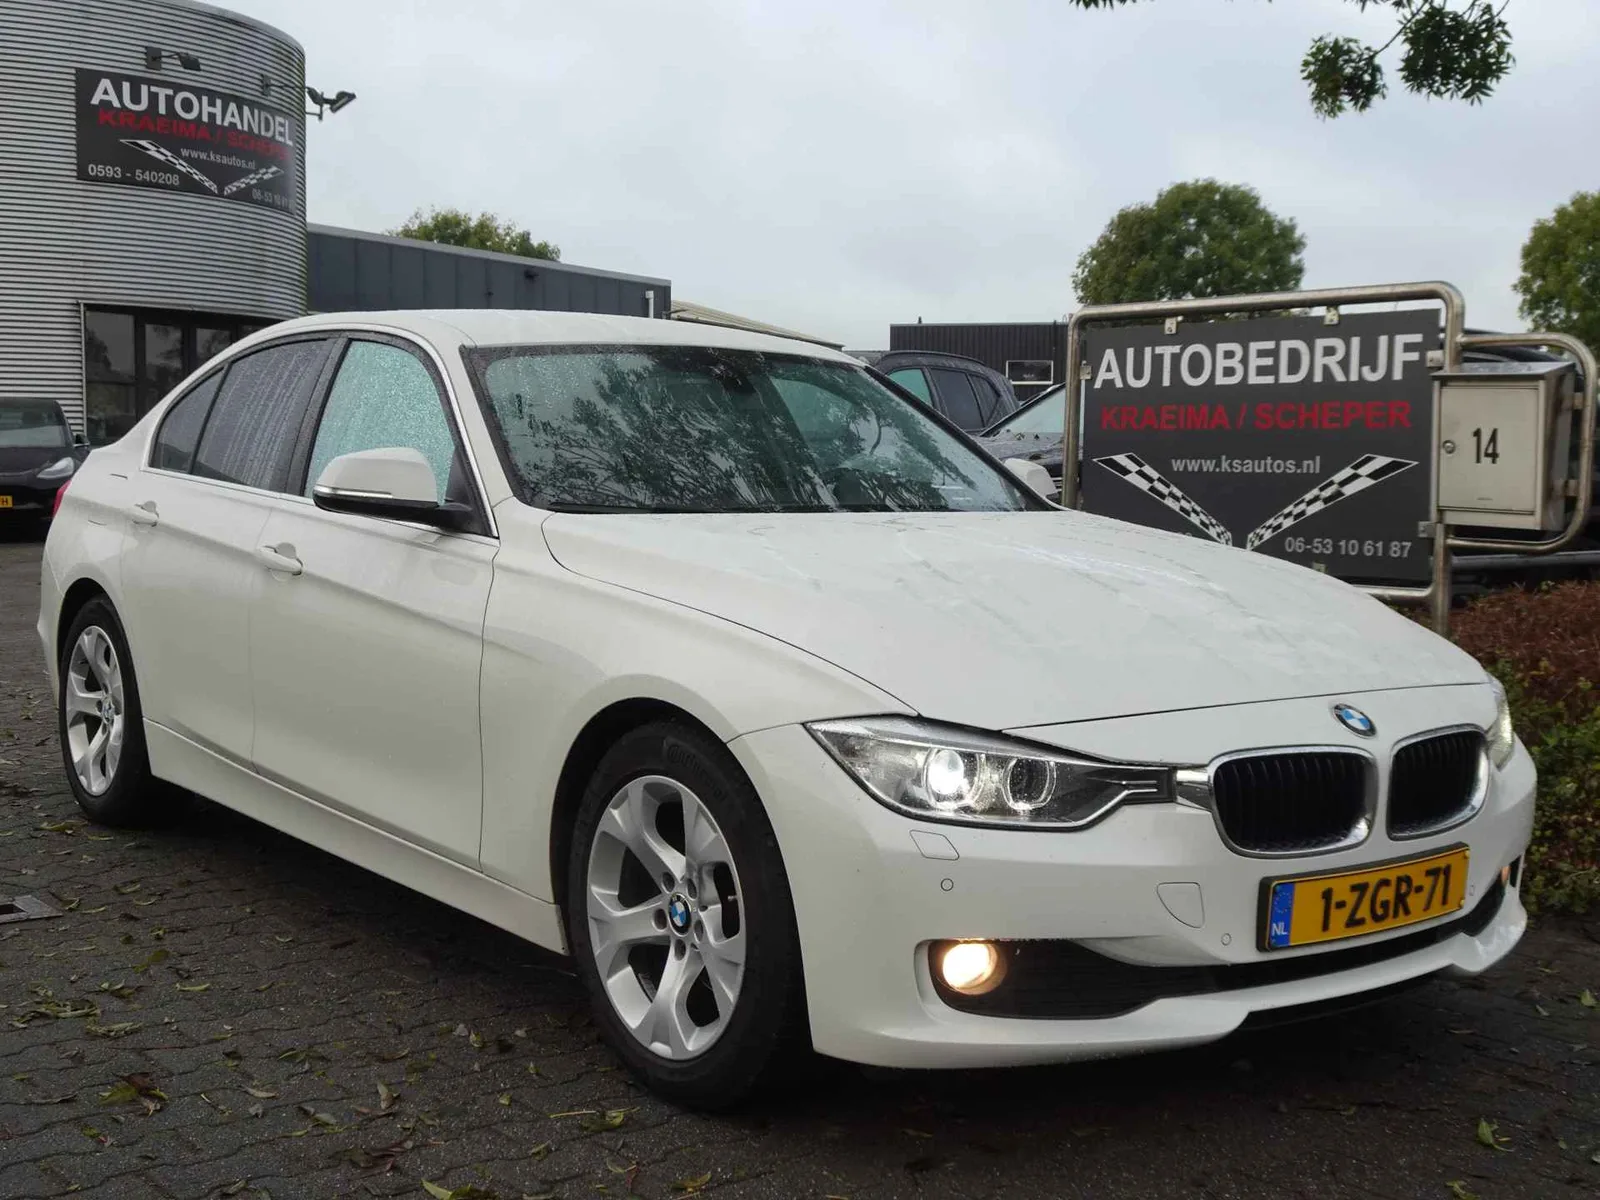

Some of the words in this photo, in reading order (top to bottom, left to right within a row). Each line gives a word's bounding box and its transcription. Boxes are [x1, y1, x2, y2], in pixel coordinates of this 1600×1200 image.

[90, 78, 293, 146] AUTOHANDEL
[97, 108, 213, 142] KRAEIMA
[181, 147, 256, 170] www.ksautos.nl
[88, 164, 122, 179] 0593
[135, 169, 180, 186] 540208
[1093, 333, 1423, 389] AUTOBEDRIJF
[1100, 405, 1231, 431] KRAEIMA
[1253, 400, 1412, 430] SCHEPER
[1472, 427, 1500, 465] 14
[1171, 456, 1320, 474] www.ksautos.nl
[1284, 537, 1333, 554] 06-53
[1338, 538, 1361, 555] 10
[1363, 539, 1384, 556] 61
[1391, 541, 1412, 558] 87
[1321, 864, 1452, 932] 1-ZGR-71
[1271, 922, 1288, 936] NL
